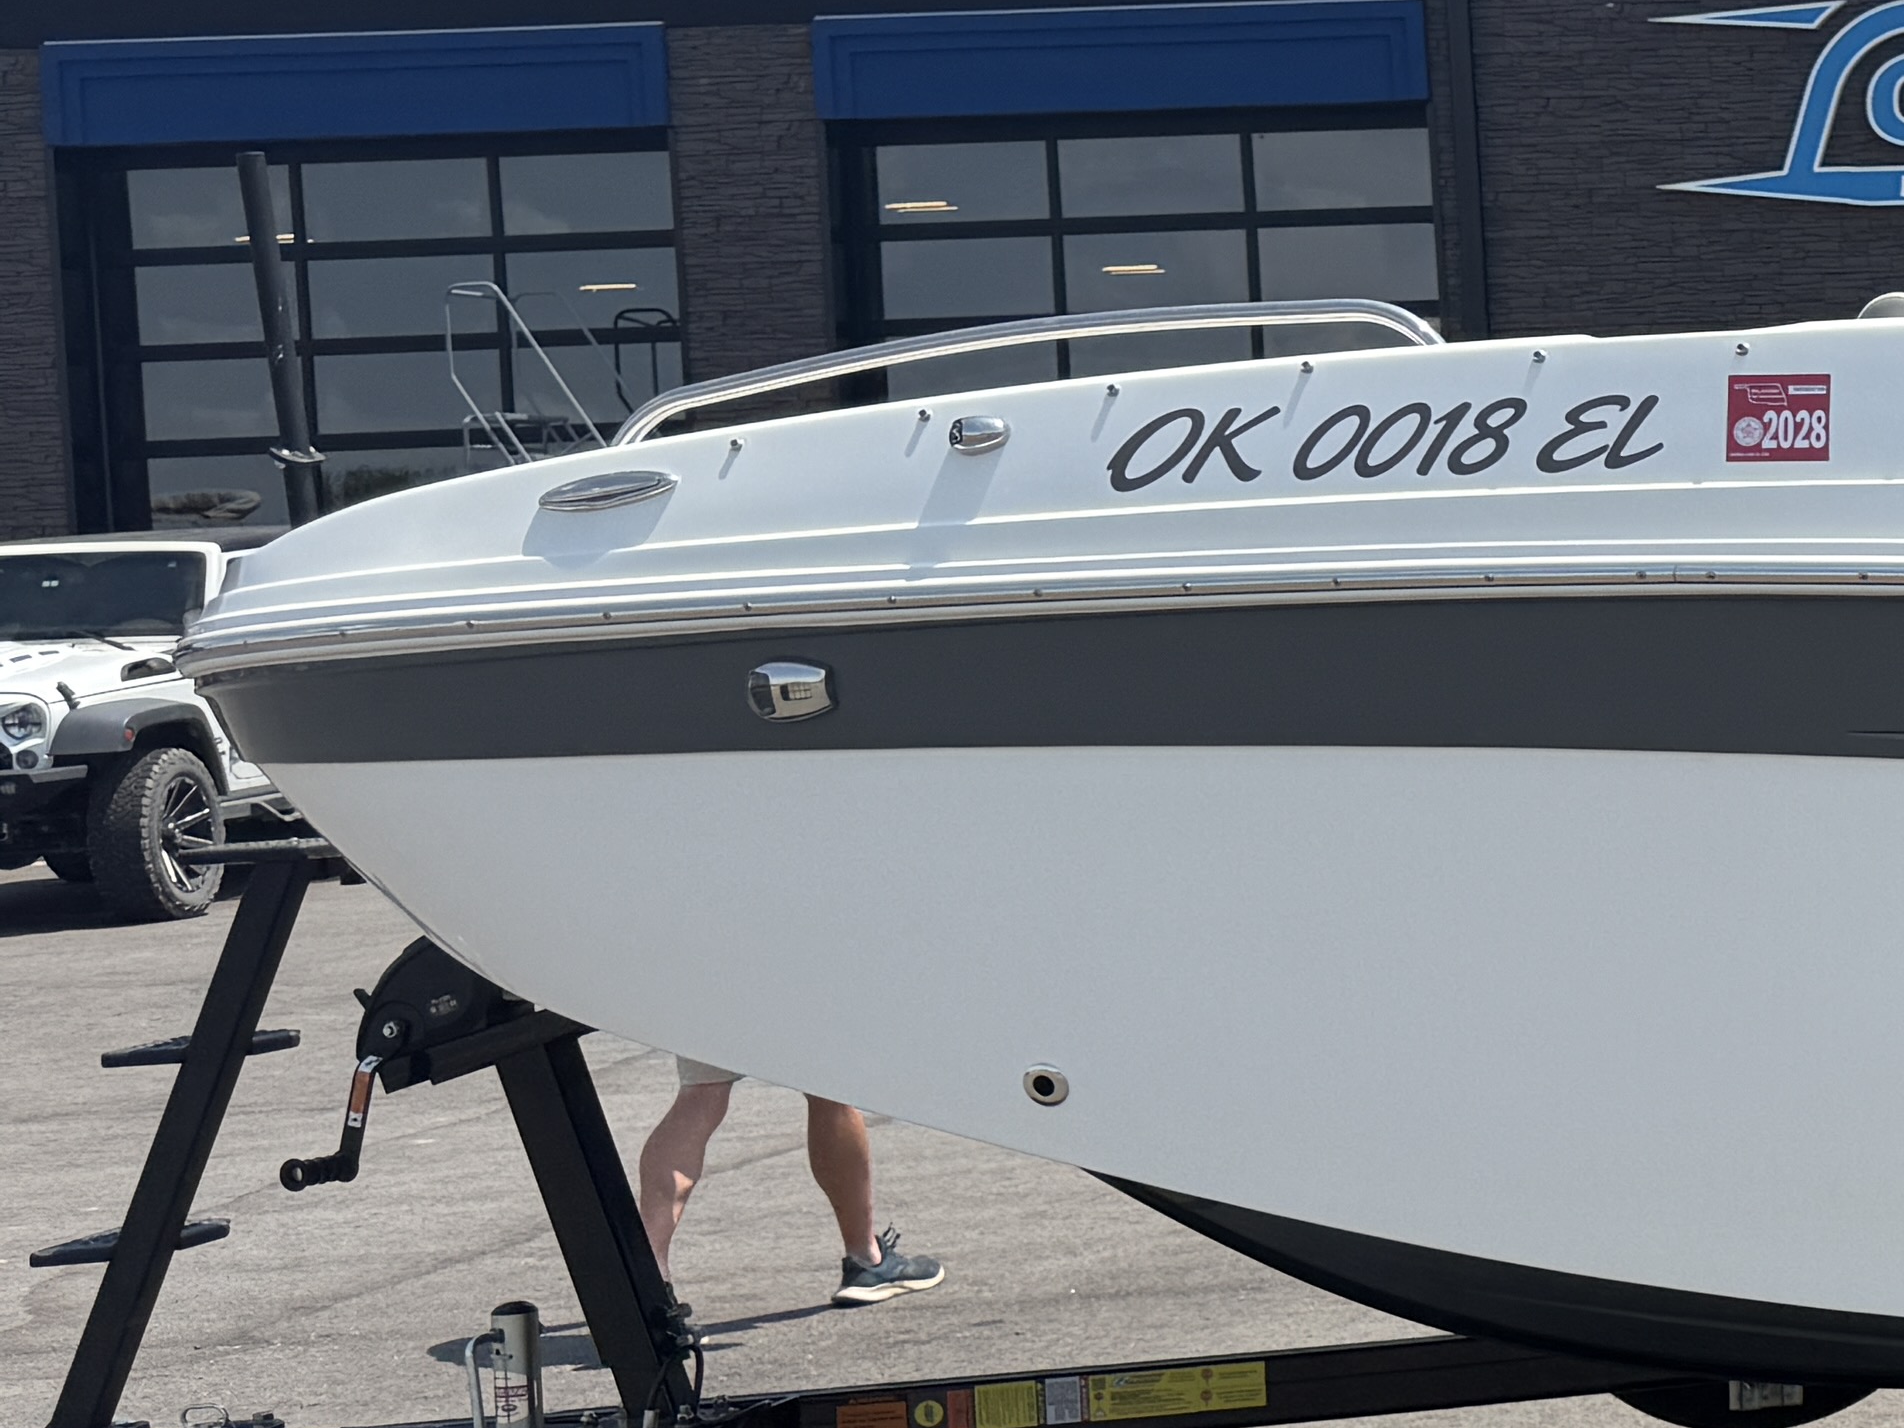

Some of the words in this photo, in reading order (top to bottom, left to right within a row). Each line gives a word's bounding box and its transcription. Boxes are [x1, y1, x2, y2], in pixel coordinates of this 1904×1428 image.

[1106, 405, 1280, 493] OK
[1292, 396, 1528, 481] 0018
[1535, 393, 1665, 474] EL
[1761, 409, 1827, 449] 2028
